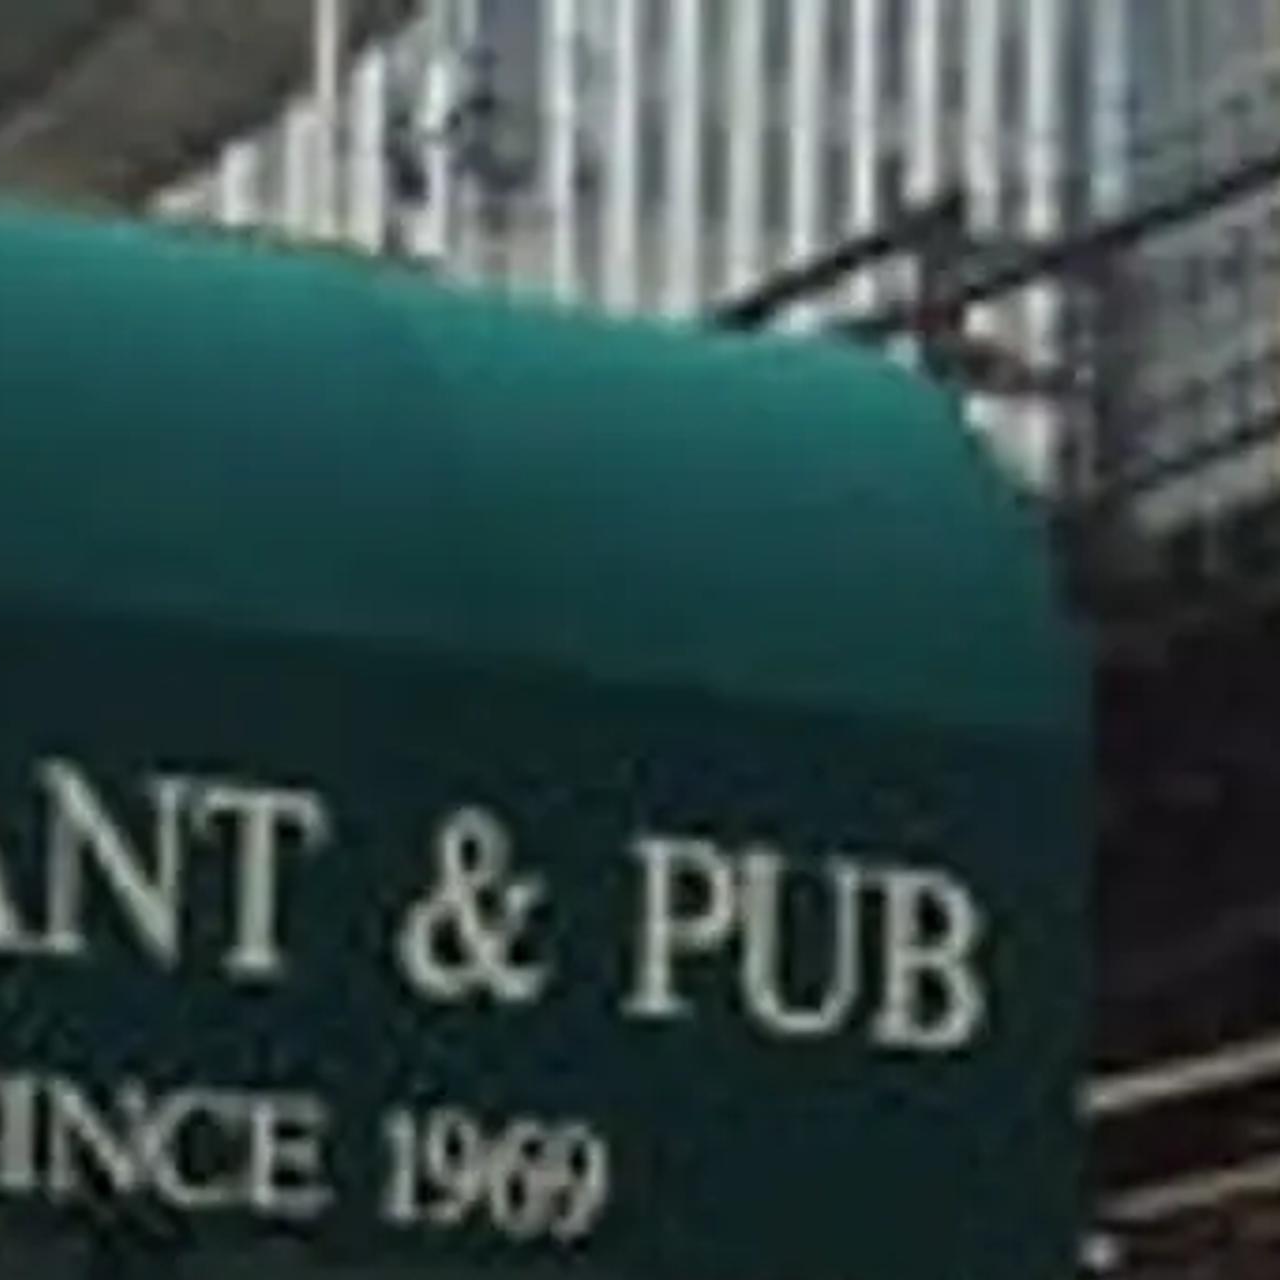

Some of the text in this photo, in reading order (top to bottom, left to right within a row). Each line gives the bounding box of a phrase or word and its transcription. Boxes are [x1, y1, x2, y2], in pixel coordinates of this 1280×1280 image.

[396, 806, 548, 1005] &
[626, 834, 987, 1051] PUB
[384, 1108, 610, 1240] 1969
